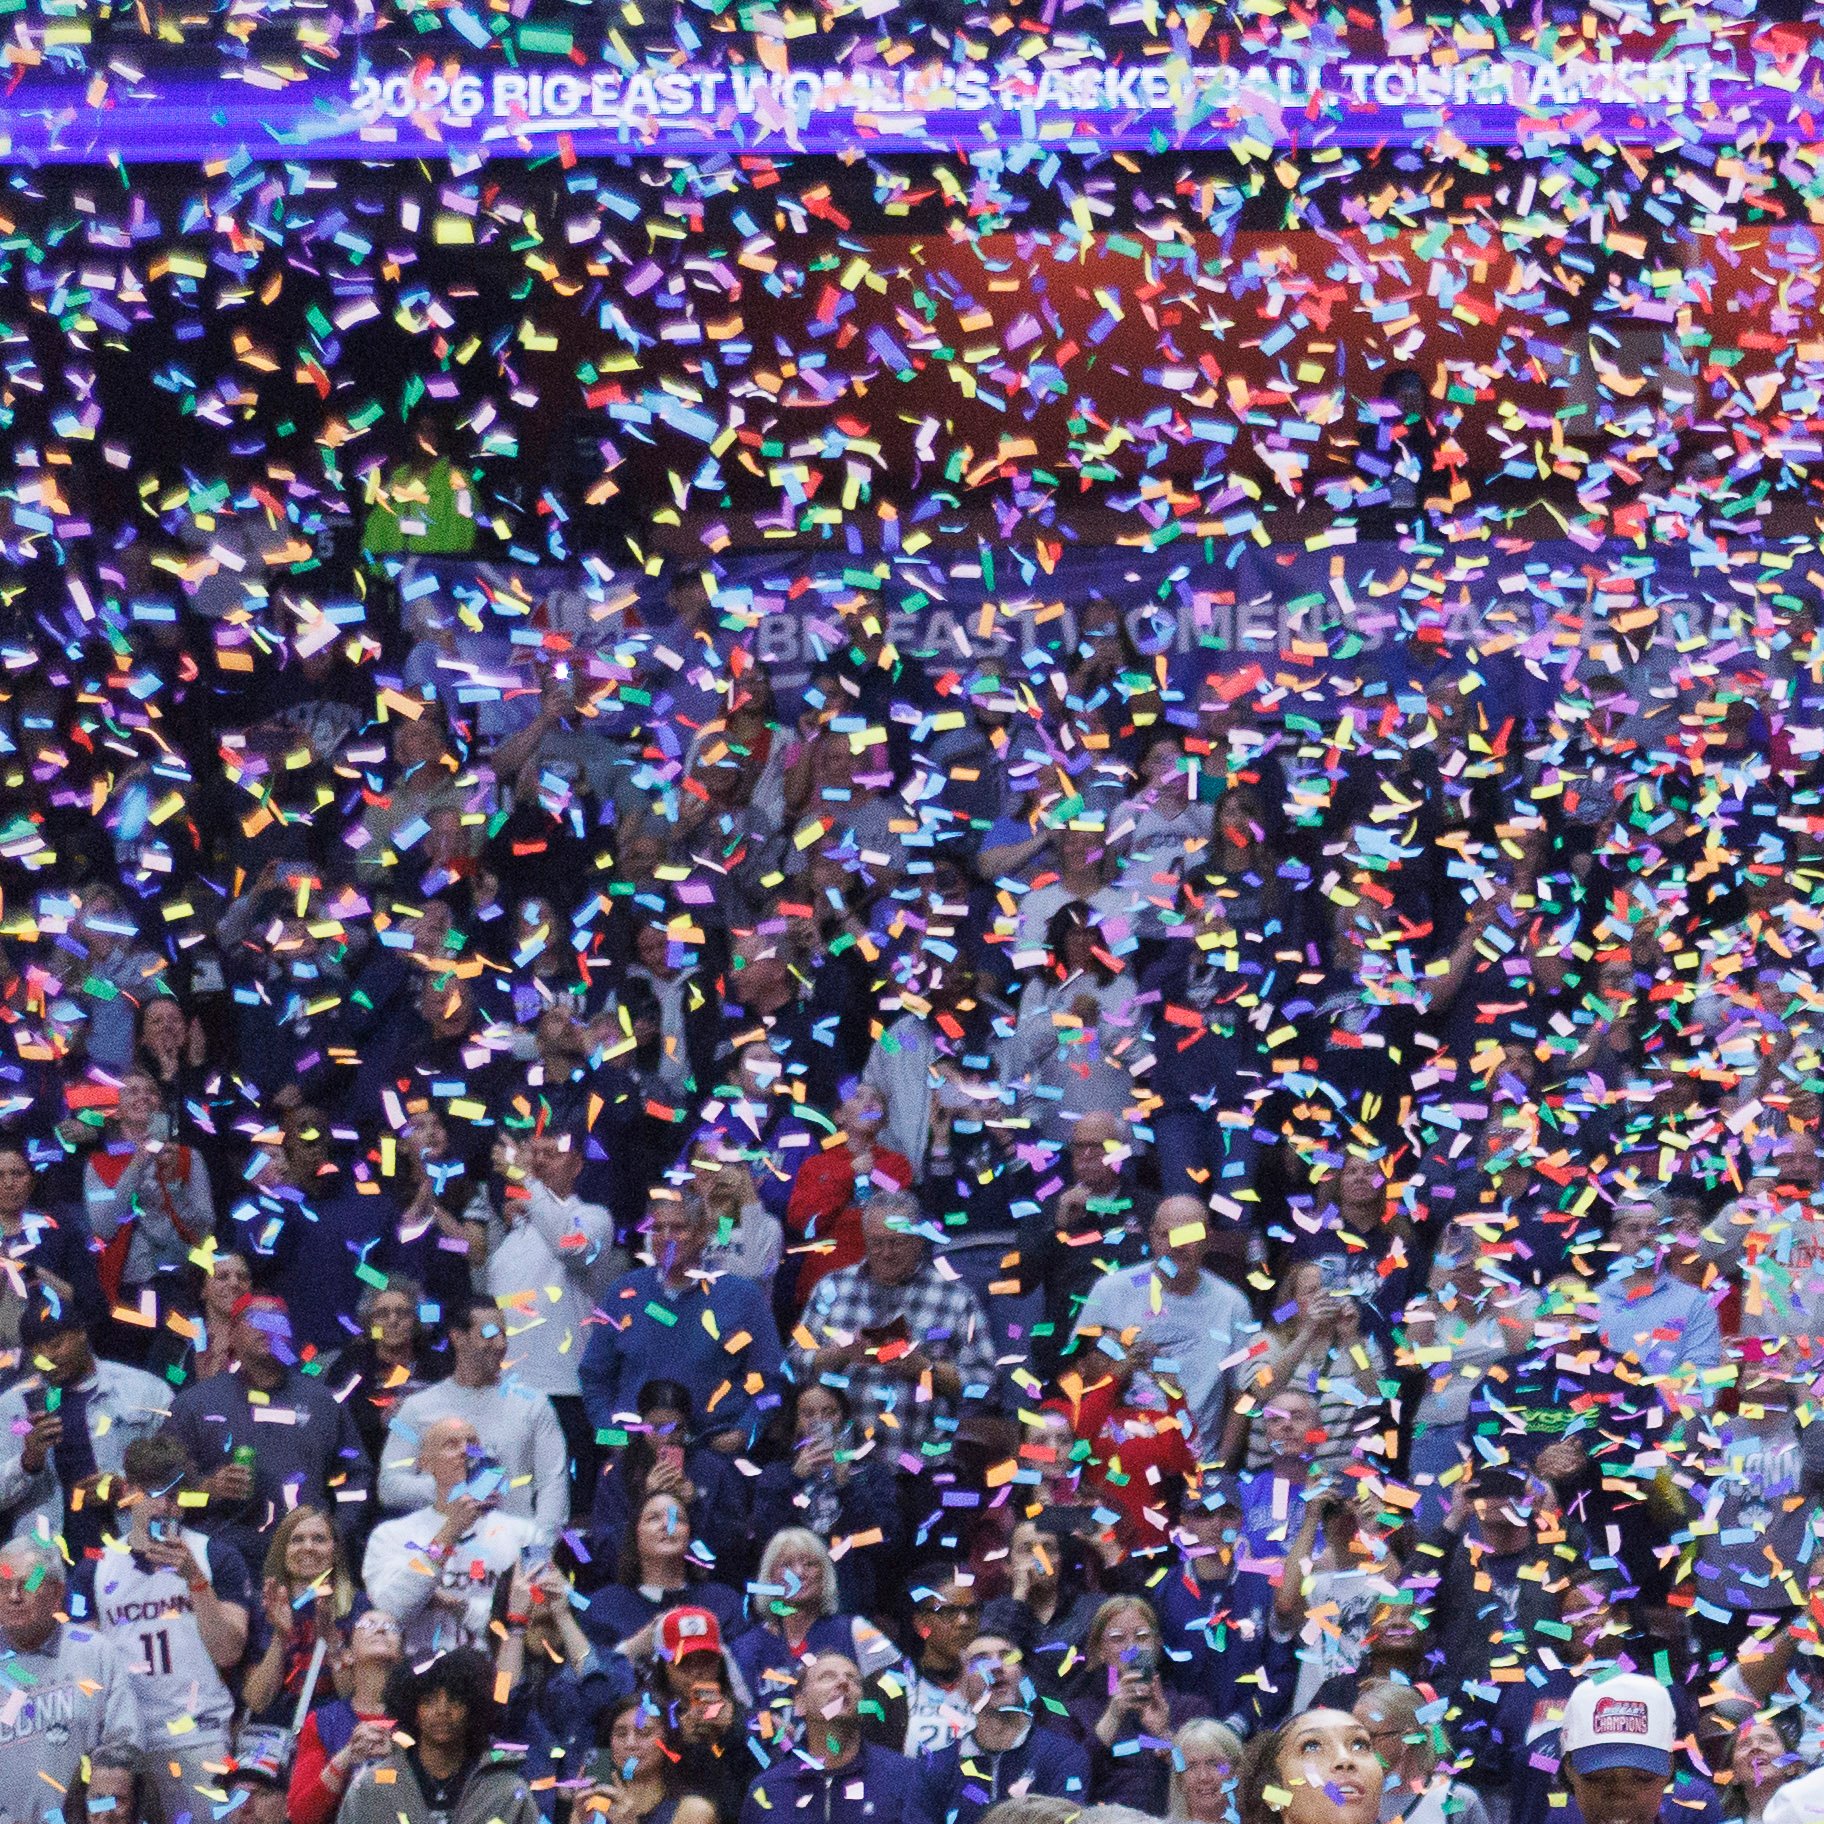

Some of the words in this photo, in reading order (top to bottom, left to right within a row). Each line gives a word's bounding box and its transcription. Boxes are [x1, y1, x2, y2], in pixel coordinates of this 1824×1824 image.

[351, 74, 485, 117] 2026
[493, 74, 582, 116] BIG
[592, 73, 727, 116] EAST
[106, 1594, 194, 1626] UCONN
[140, 1630, 171, 1676] 11
[1594, 1716, 1648, 1734] CHAMPIONS
